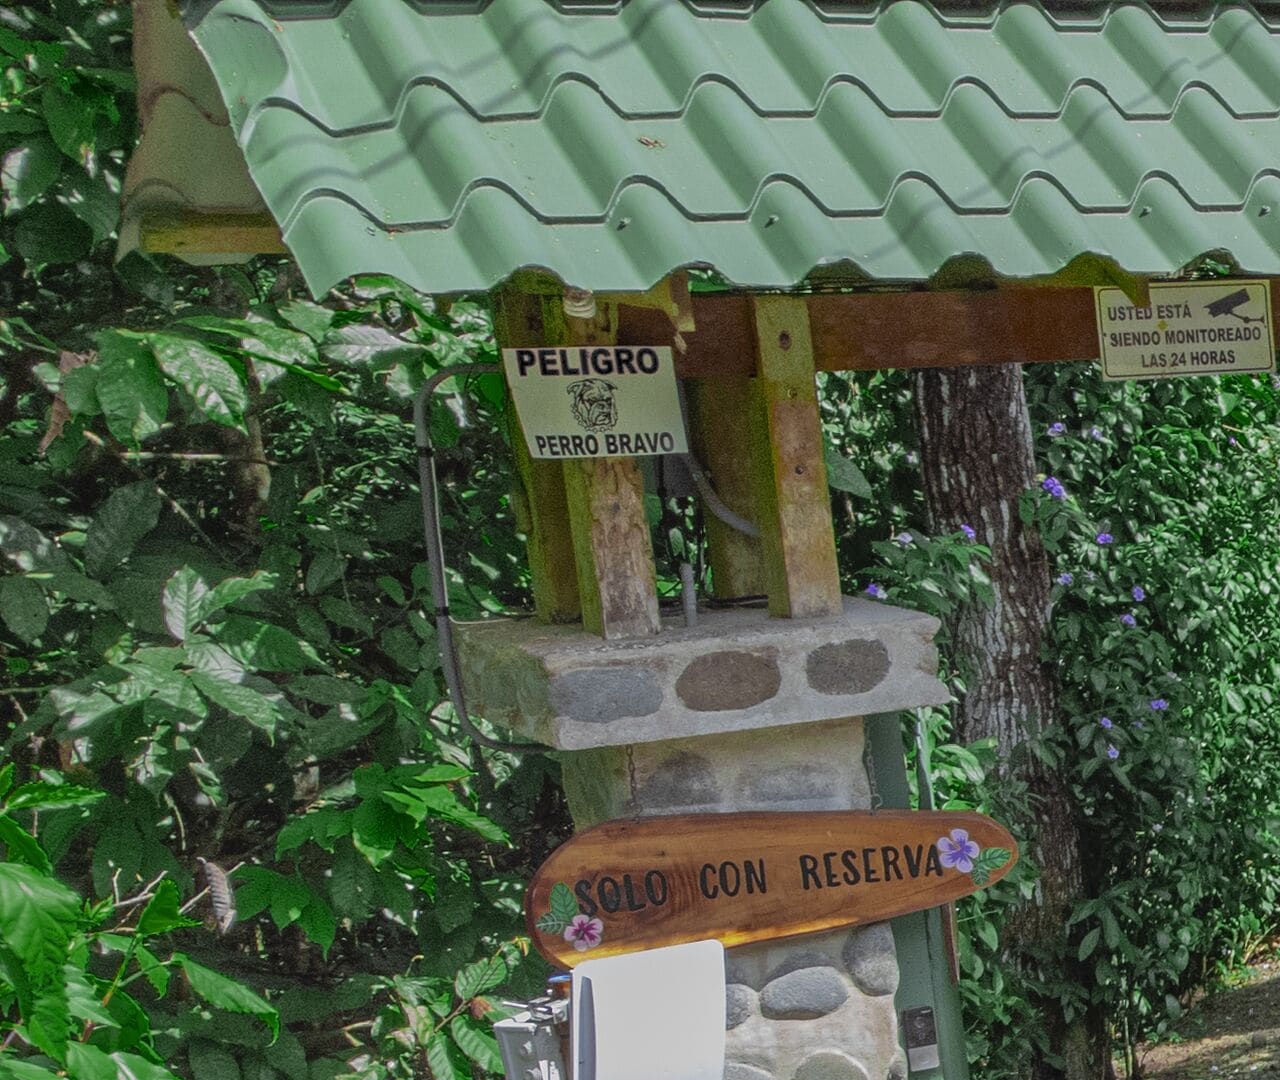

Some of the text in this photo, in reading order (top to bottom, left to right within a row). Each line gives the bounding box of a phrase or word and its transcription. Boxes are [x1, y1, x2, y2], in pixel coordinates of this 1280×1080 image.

[1157, 302, 1192, 319] ESTÁ
[1110, 326, 1261, 347] SIENDO MONITOREADO
[516, 348, 659, 377] PELIGRO
[1141, 350, 1236, 368] LAS 24 HORAS
[535, 432, 675, 456] PERRO BRAVO
[574, 843, 944, 917] SOLO CON RESERVA
